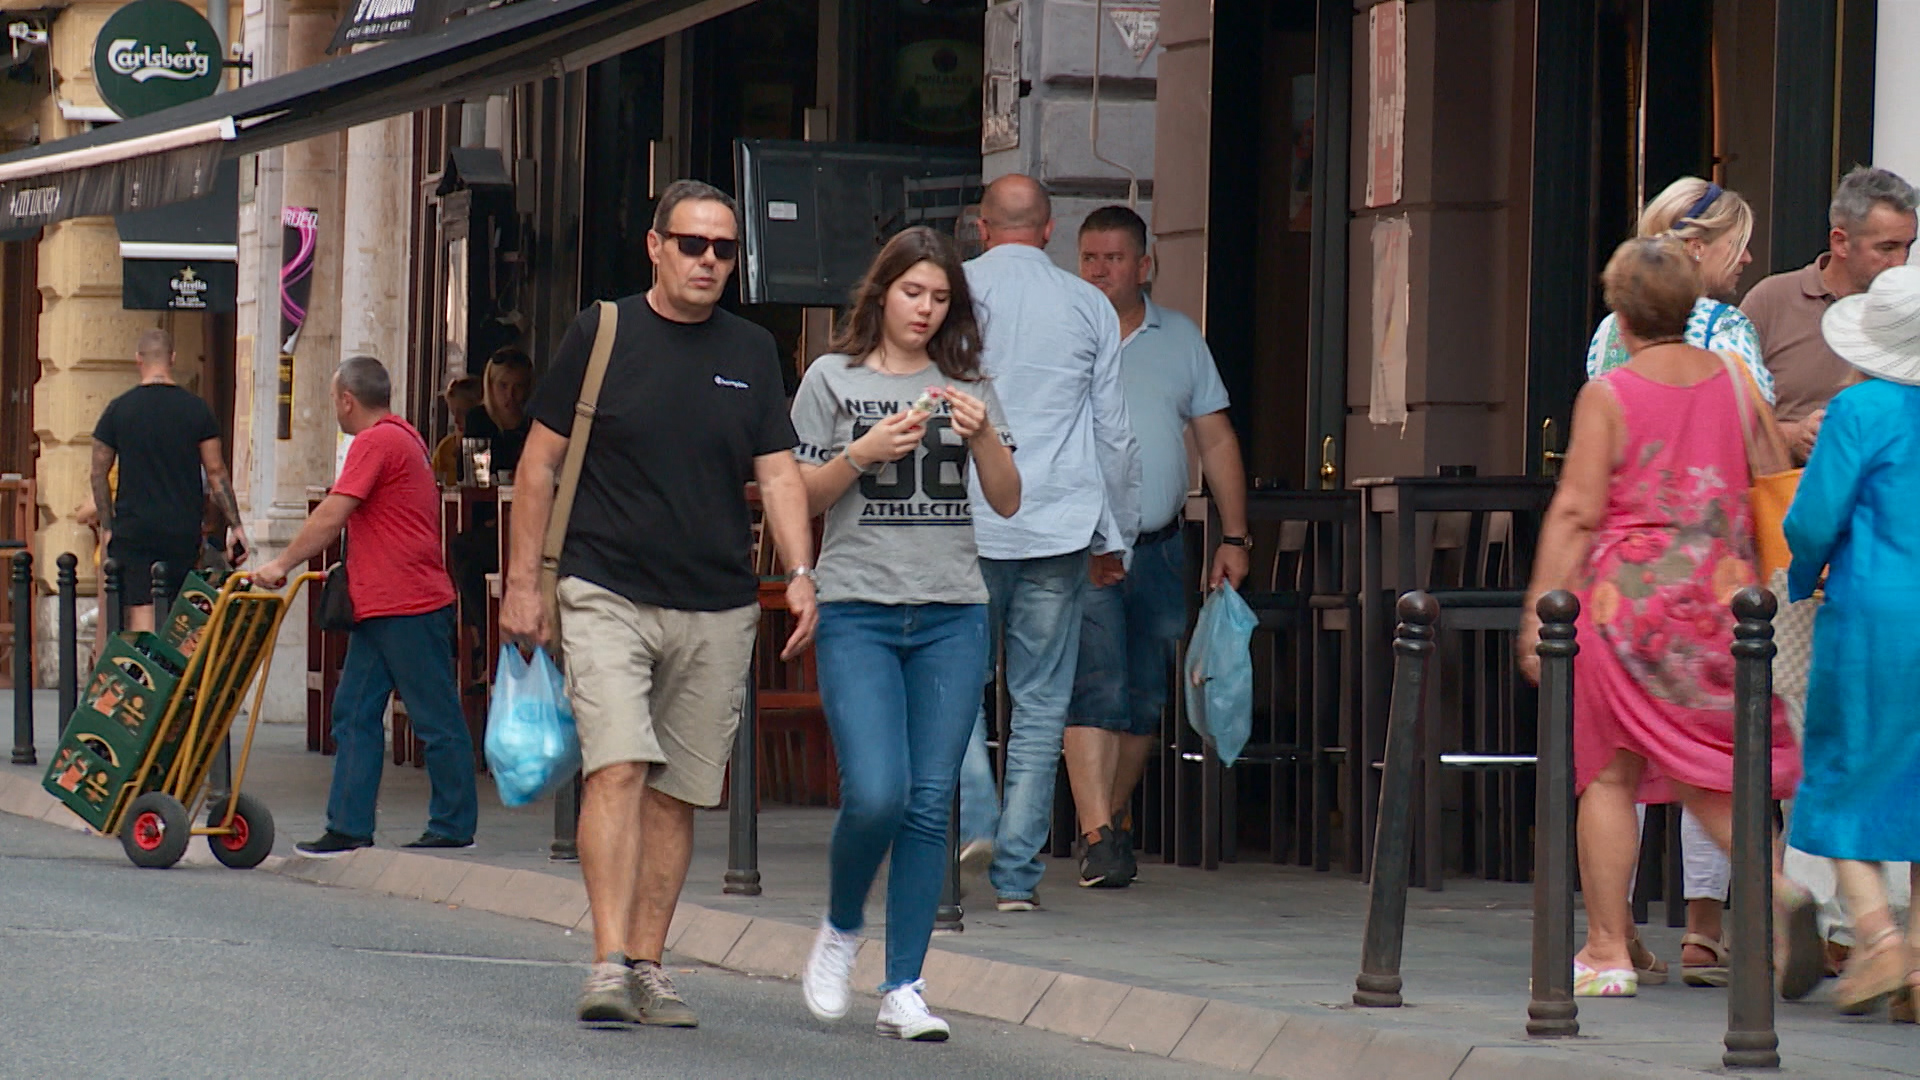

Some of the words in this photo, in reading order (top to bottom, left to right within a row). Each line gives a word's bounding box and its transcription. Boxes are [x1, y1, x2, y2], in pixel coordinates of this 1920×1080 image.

[108, 39, 209, 78] Carlsberg
[845, 398, 899, 416] NEW
[861, 502, 972, 517] ATHLECTIC
